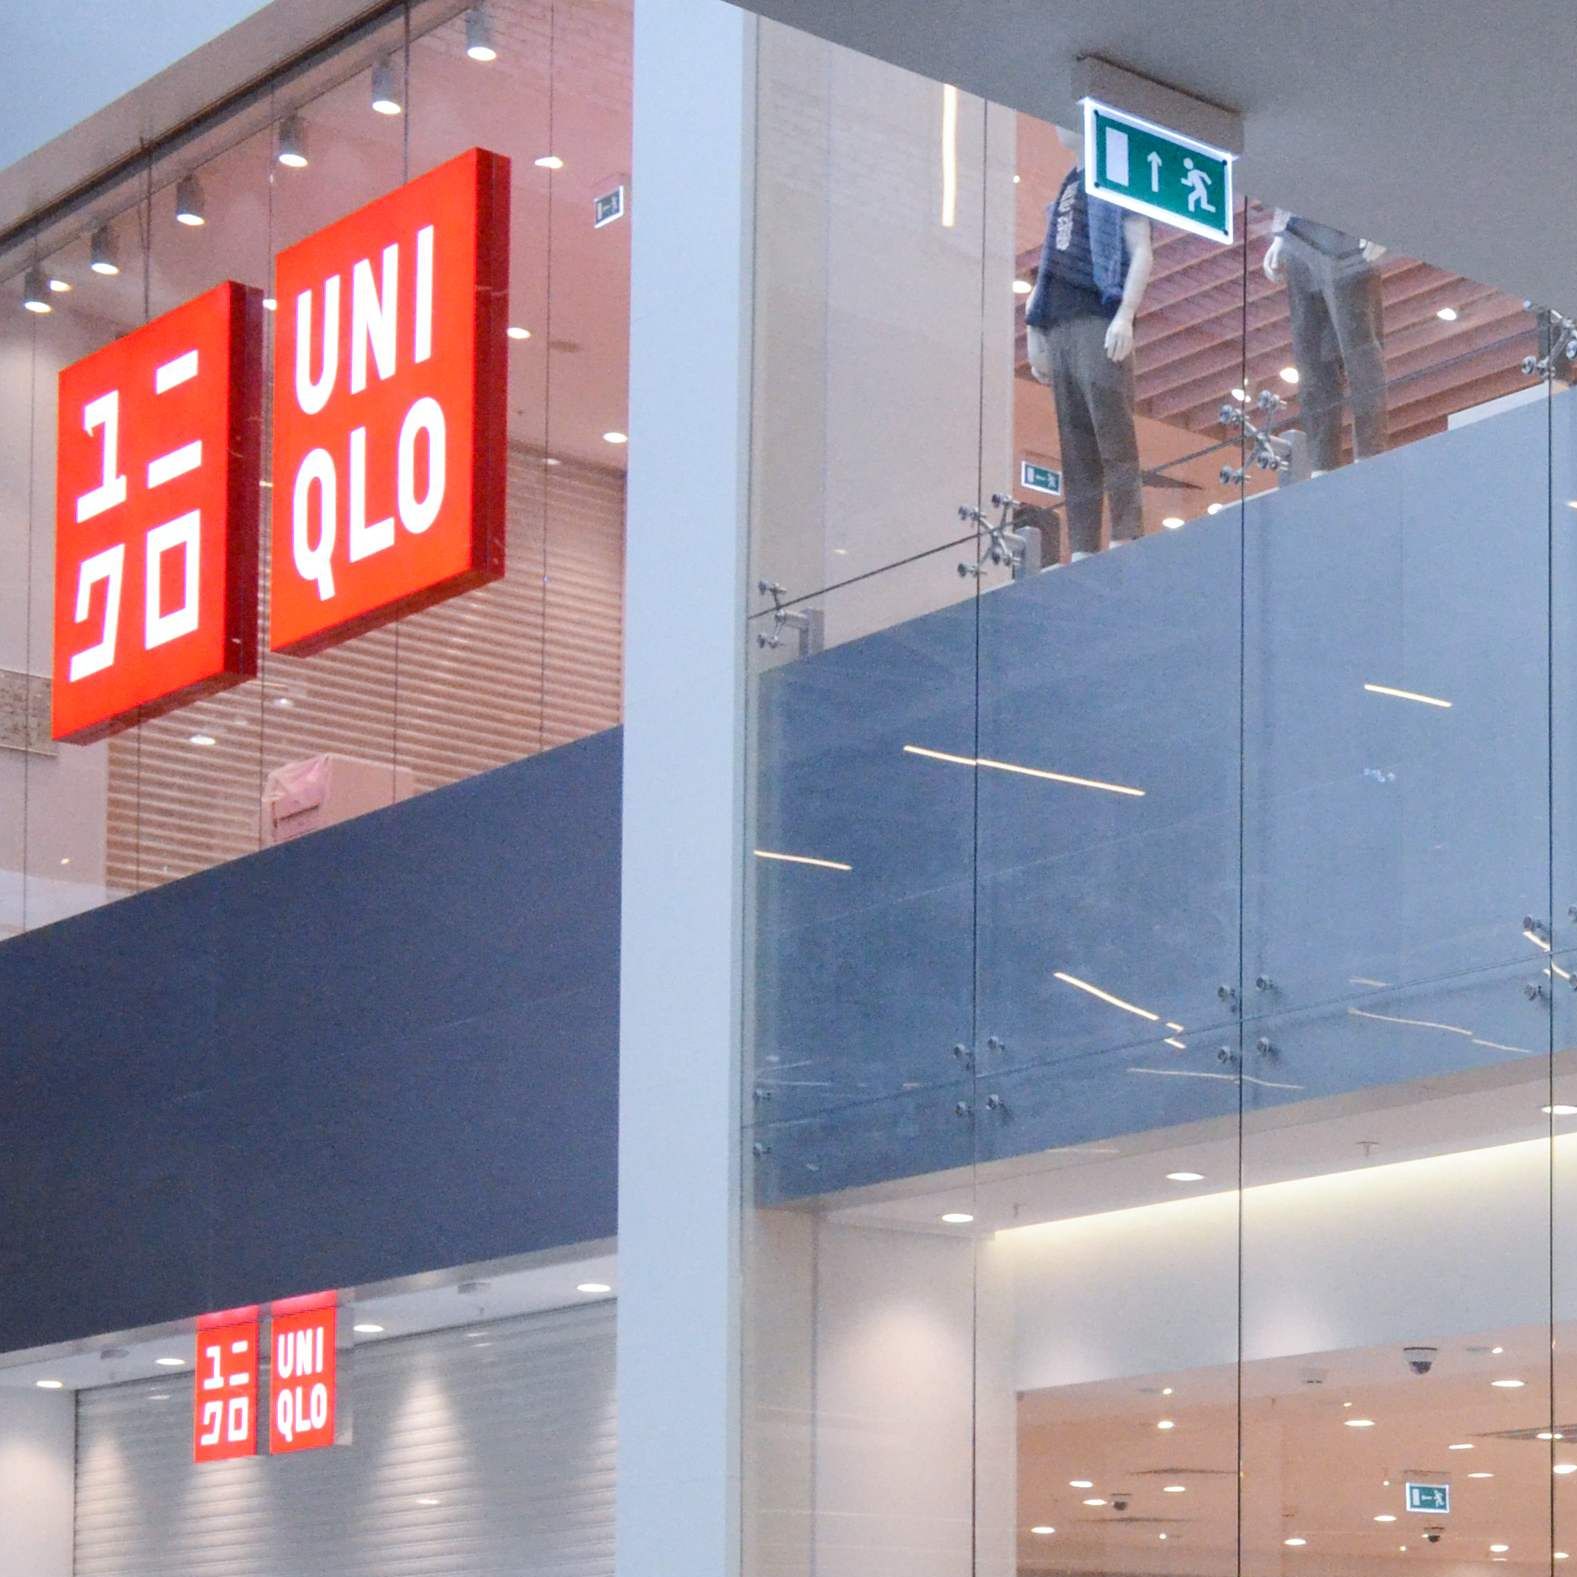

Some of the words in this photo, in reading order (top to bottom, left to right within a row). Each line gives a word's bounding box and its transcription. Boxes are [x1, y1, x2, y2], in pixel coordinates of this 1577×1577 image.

[294, 225, 434, 416] UNI
[75, 350, 203, 524] ユニ
[291, 396, 447, 601] QLO
[69, 509, 202, 683] クロ
[203, 1339, 249, 1391] ユニ
[277, 1326, 325, 1379] UNI
[199, 1396, 250, 1446] クロ
[276, 1382, 328, 1442] QLO
